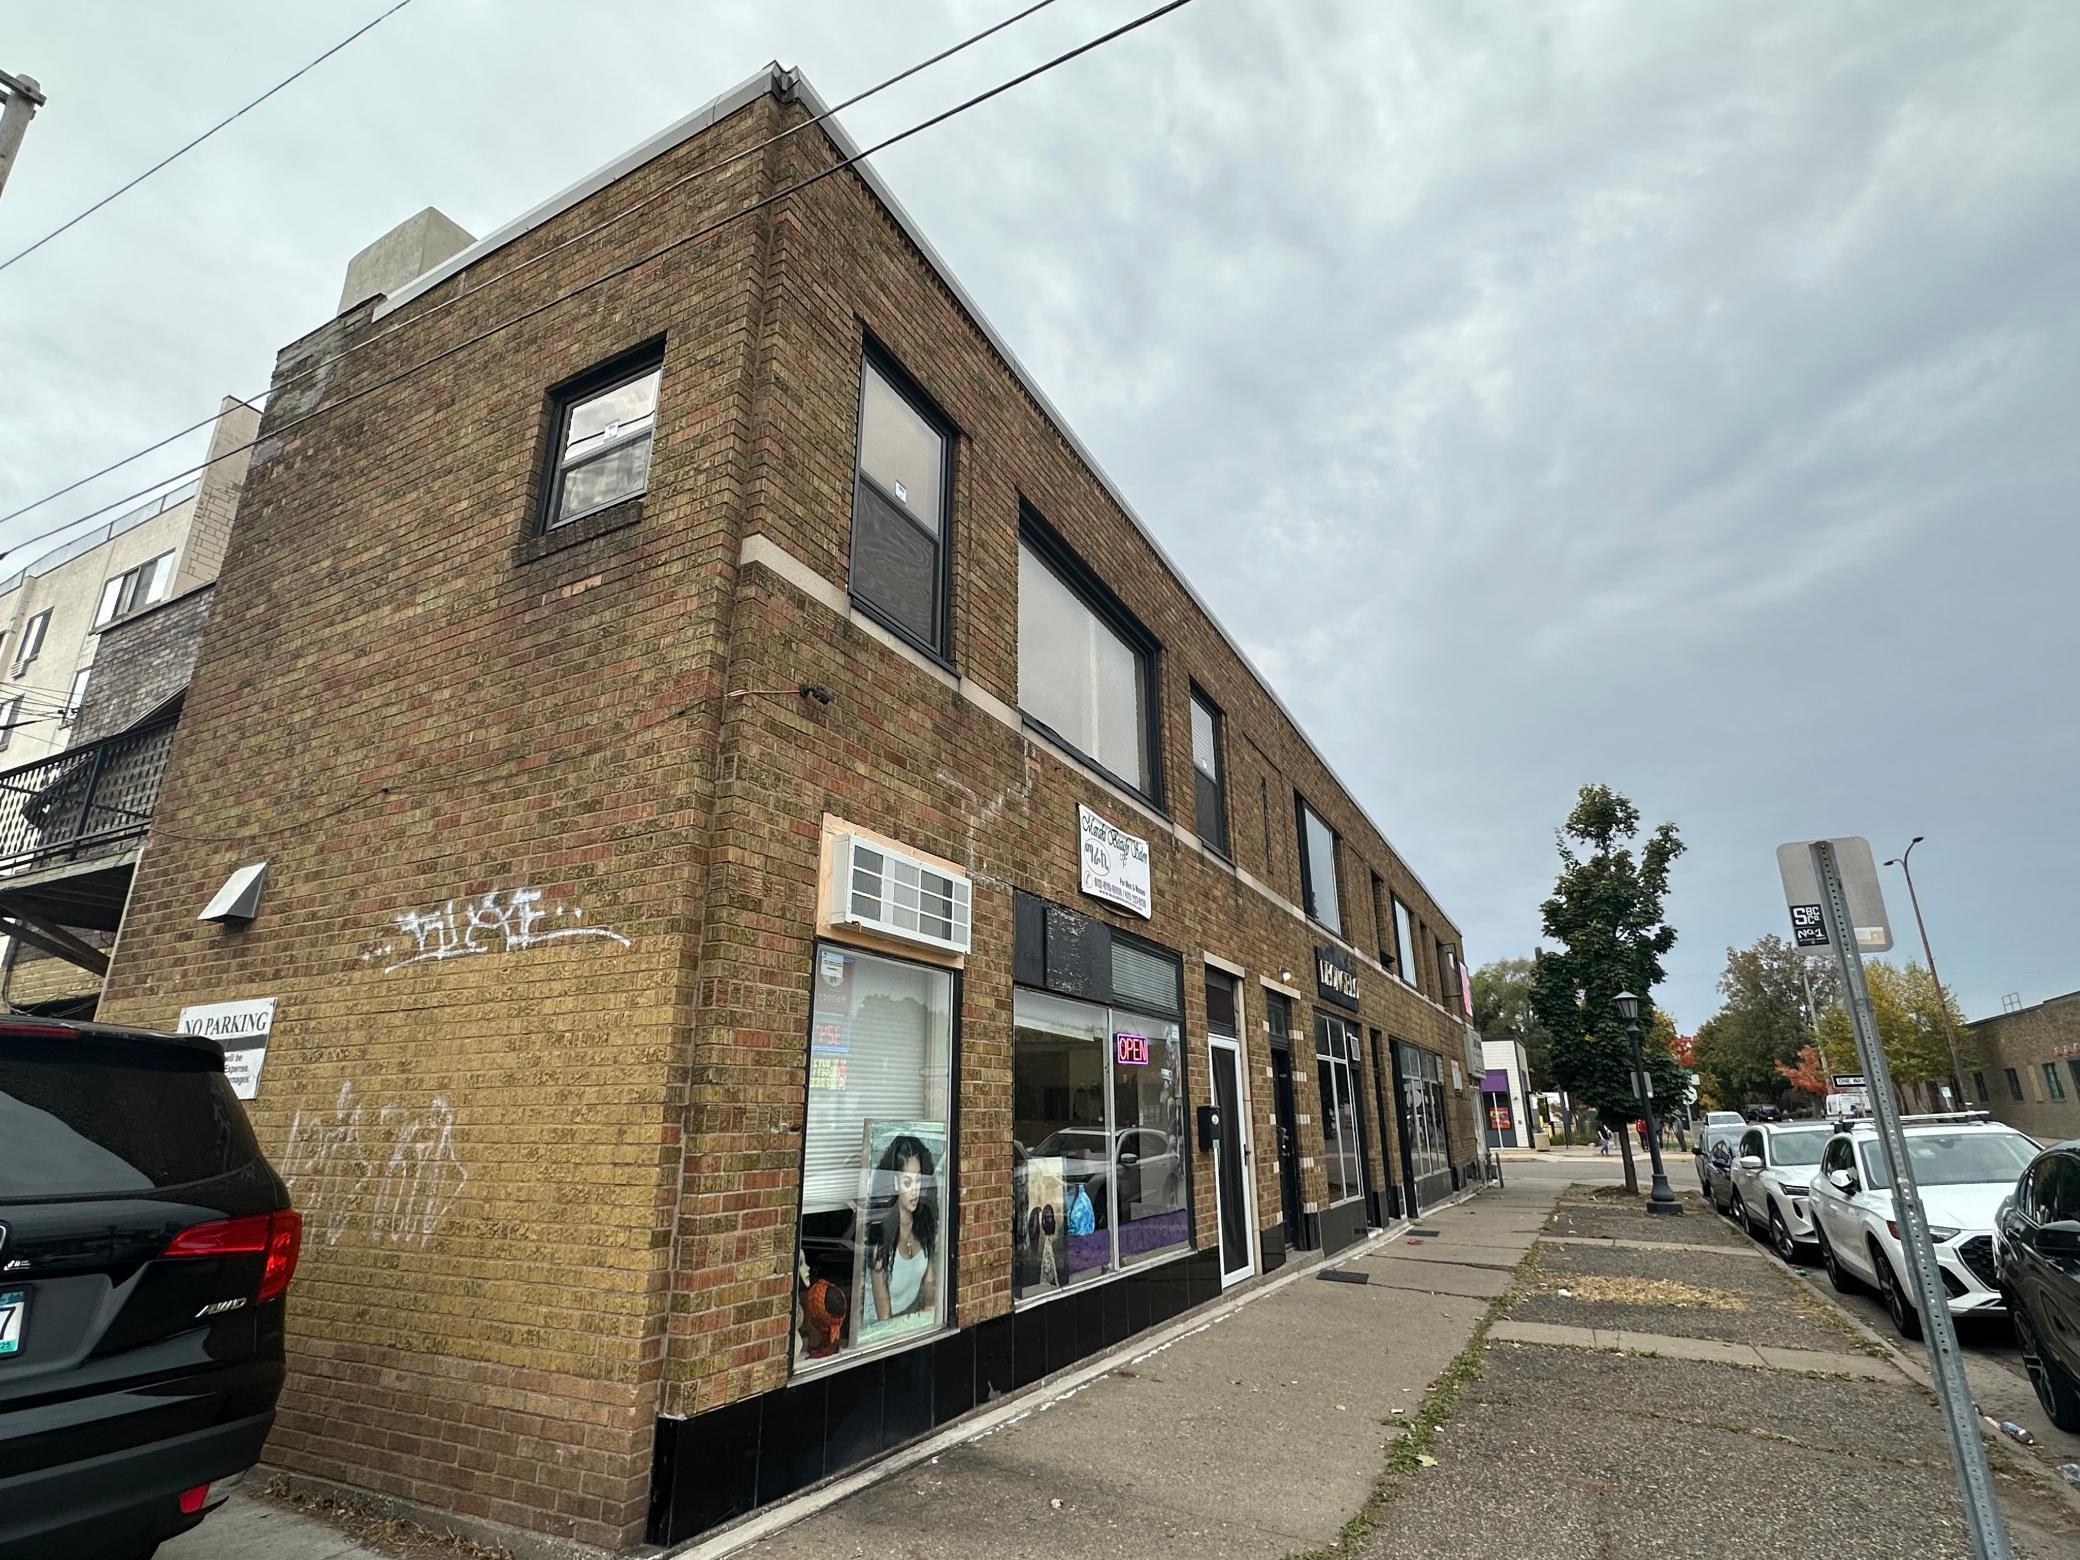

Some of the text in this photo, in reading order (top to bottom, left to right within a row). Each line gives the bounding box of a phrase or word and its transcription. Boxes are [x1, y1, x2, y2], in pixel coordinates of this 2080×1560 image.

[184, 1011, 268, 1036] NO PARKING
[235, 1053, 243, 1062] be
[1119, 1037, 1147, 1061] OPEN
[195, 1297, 248, 1318] AWD
